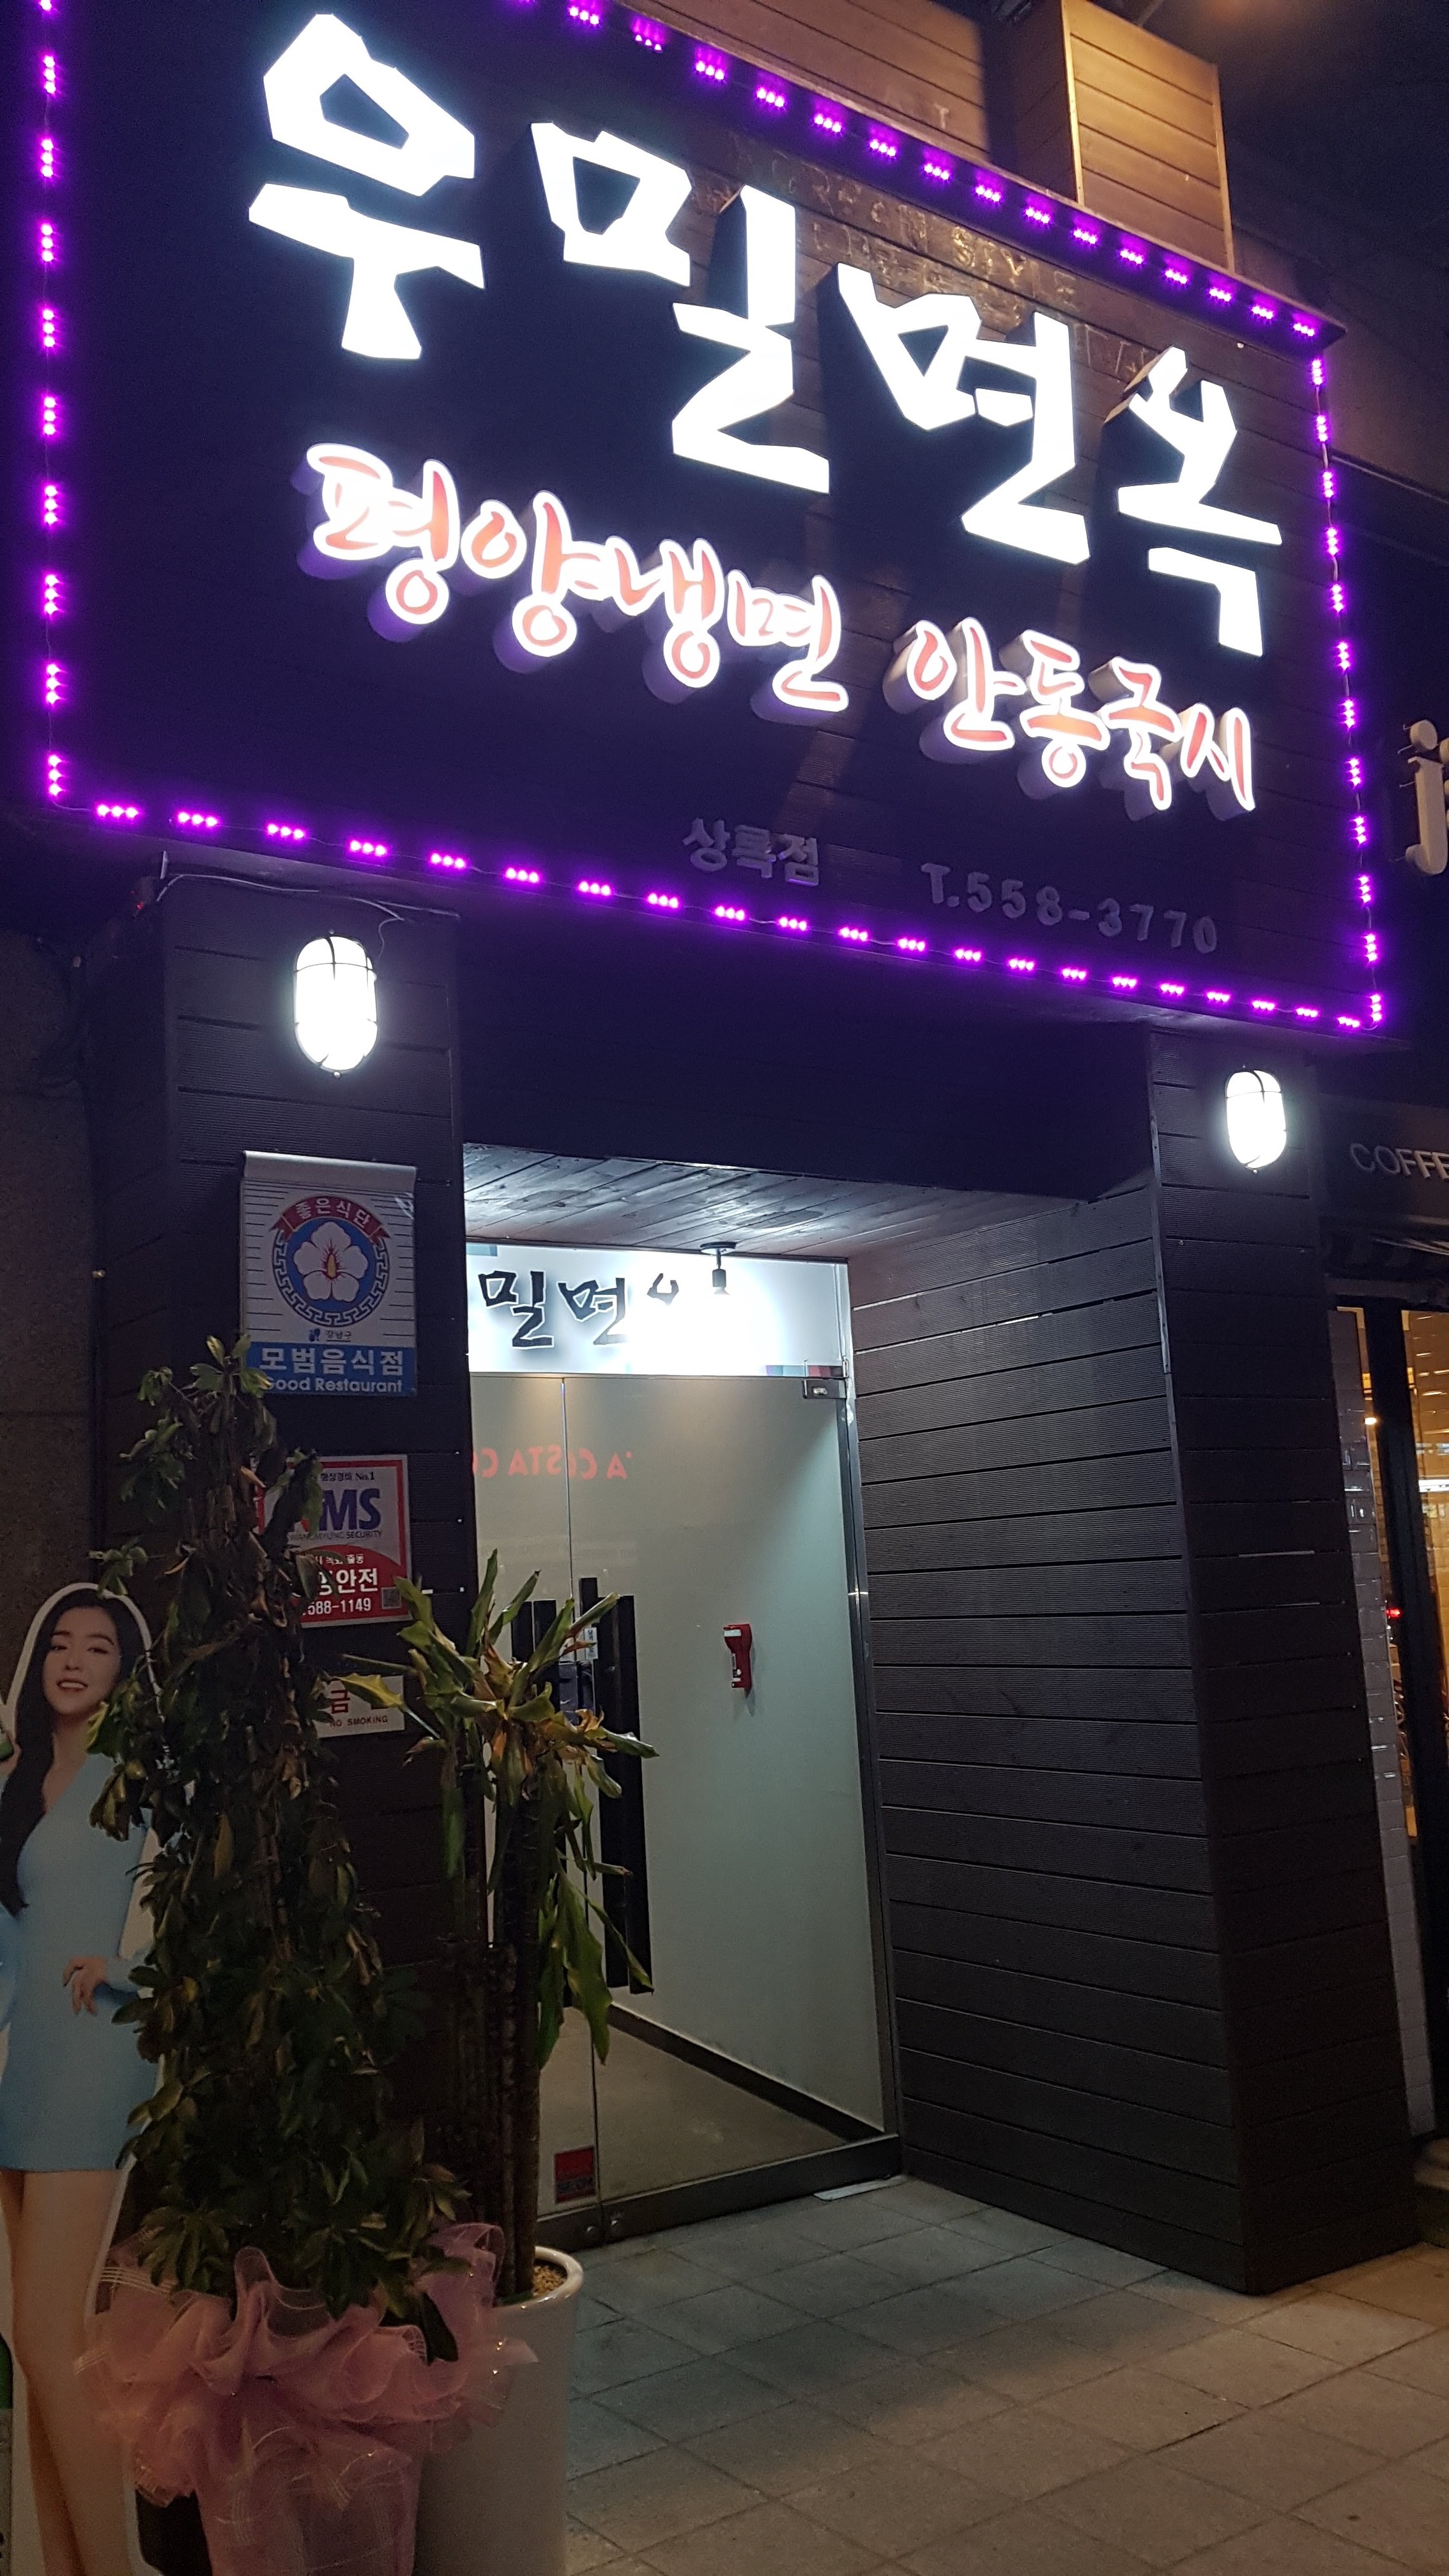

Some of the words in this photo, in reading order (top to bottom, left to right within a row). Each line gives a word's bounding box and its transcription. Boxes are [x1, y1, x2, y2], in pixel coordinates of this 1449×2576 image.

[307, 443, 849, 712] 평양냉면
[902, 617, 1256, 811] 안동국시
[921, 862, 1218, 954] T.558-3770
[259, 1347, 404, 1376] 모범음식점
[315, 1377, 402, 1393] Restaurant
[319, 1488, 381, 1531] MS
[302, 1597, 372, 1616] 588-1149
[347, 1715, 388, 1726] SMOKING
